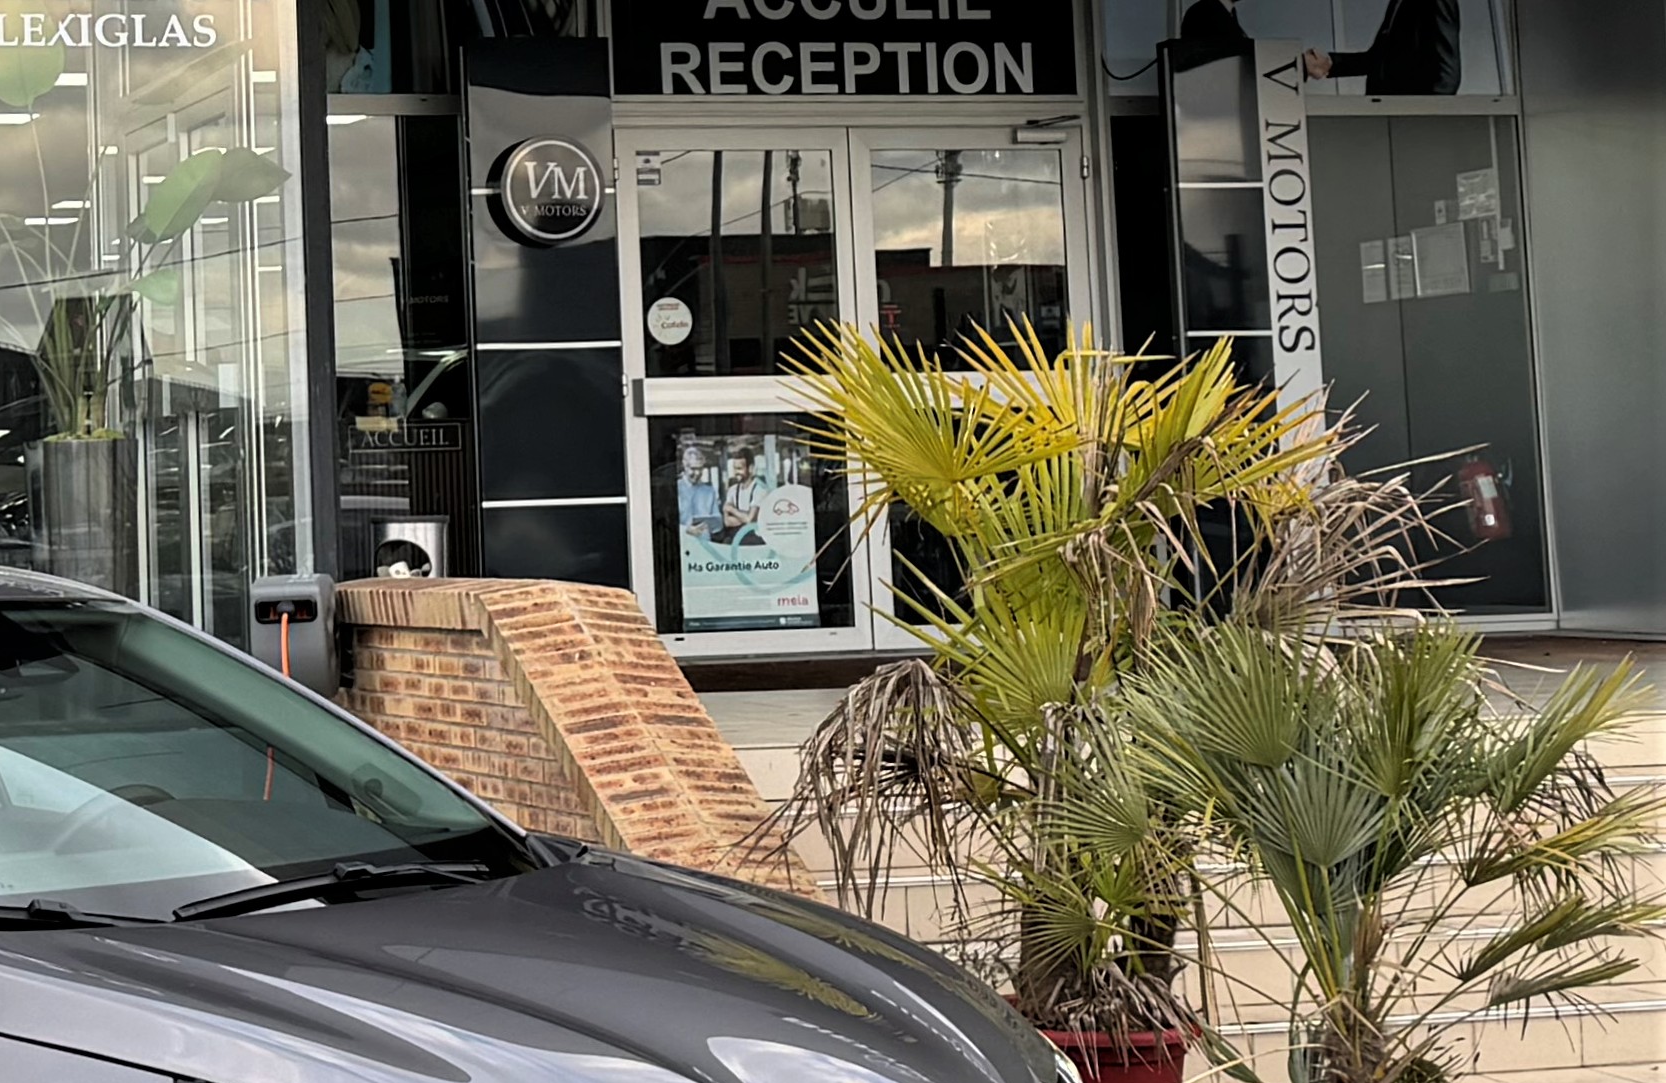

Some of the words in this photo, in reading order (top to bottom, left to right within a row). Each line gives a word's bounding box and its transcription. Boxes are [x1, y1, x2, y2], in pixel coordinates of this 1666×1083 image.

[660, 41, 1035, 95] RECEPTION
[1262, 57, 1300, 95] V
[524, 161, 589, 200] VM
[520, 205, 530, 216] V
[535, 205, 587, 217] MOTORS
[1265, 119, 1316, 353] MOTORS
[361, 427, 450, 448] ACCUEIL
[705, 562, 751, 572] Garantie
[754, 561, 779, 571] Auto
